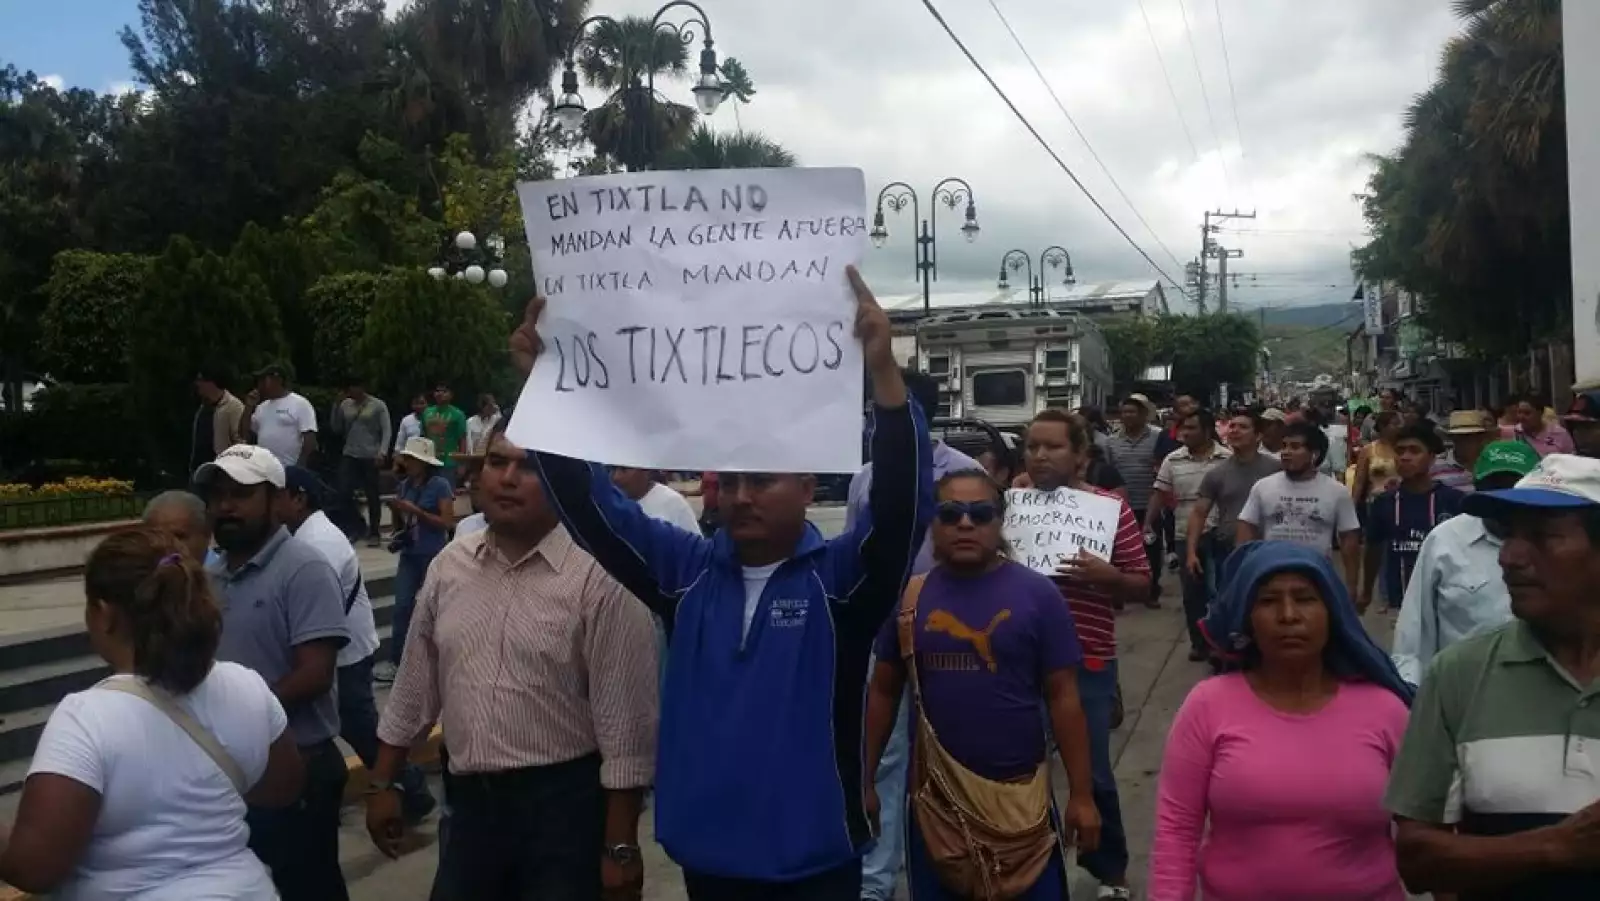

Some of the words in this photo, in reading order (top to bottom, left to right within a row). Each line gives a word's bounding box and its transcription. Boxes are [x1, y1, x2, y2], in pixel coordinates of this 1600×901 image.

[546, 191, 579, 221] EN
[589, 185, 709, 215] TIXTLA
[721, 184, 769, 213] NO
[551, 225, 632, 257] MANDAN
[649, 226, 677, 249] LA
[688, 221, 767, 246] GENTE
[777, 215, 867, 241] AFUERA
[576, 271, 653, 292] TIXTLA
[682, 256, 830, 285] MANDAN
[554, 331, 610, 392] LOS
[616, 321, 844, 386] TIXTLECOS
[1034, 531, 1062, 547] EN
